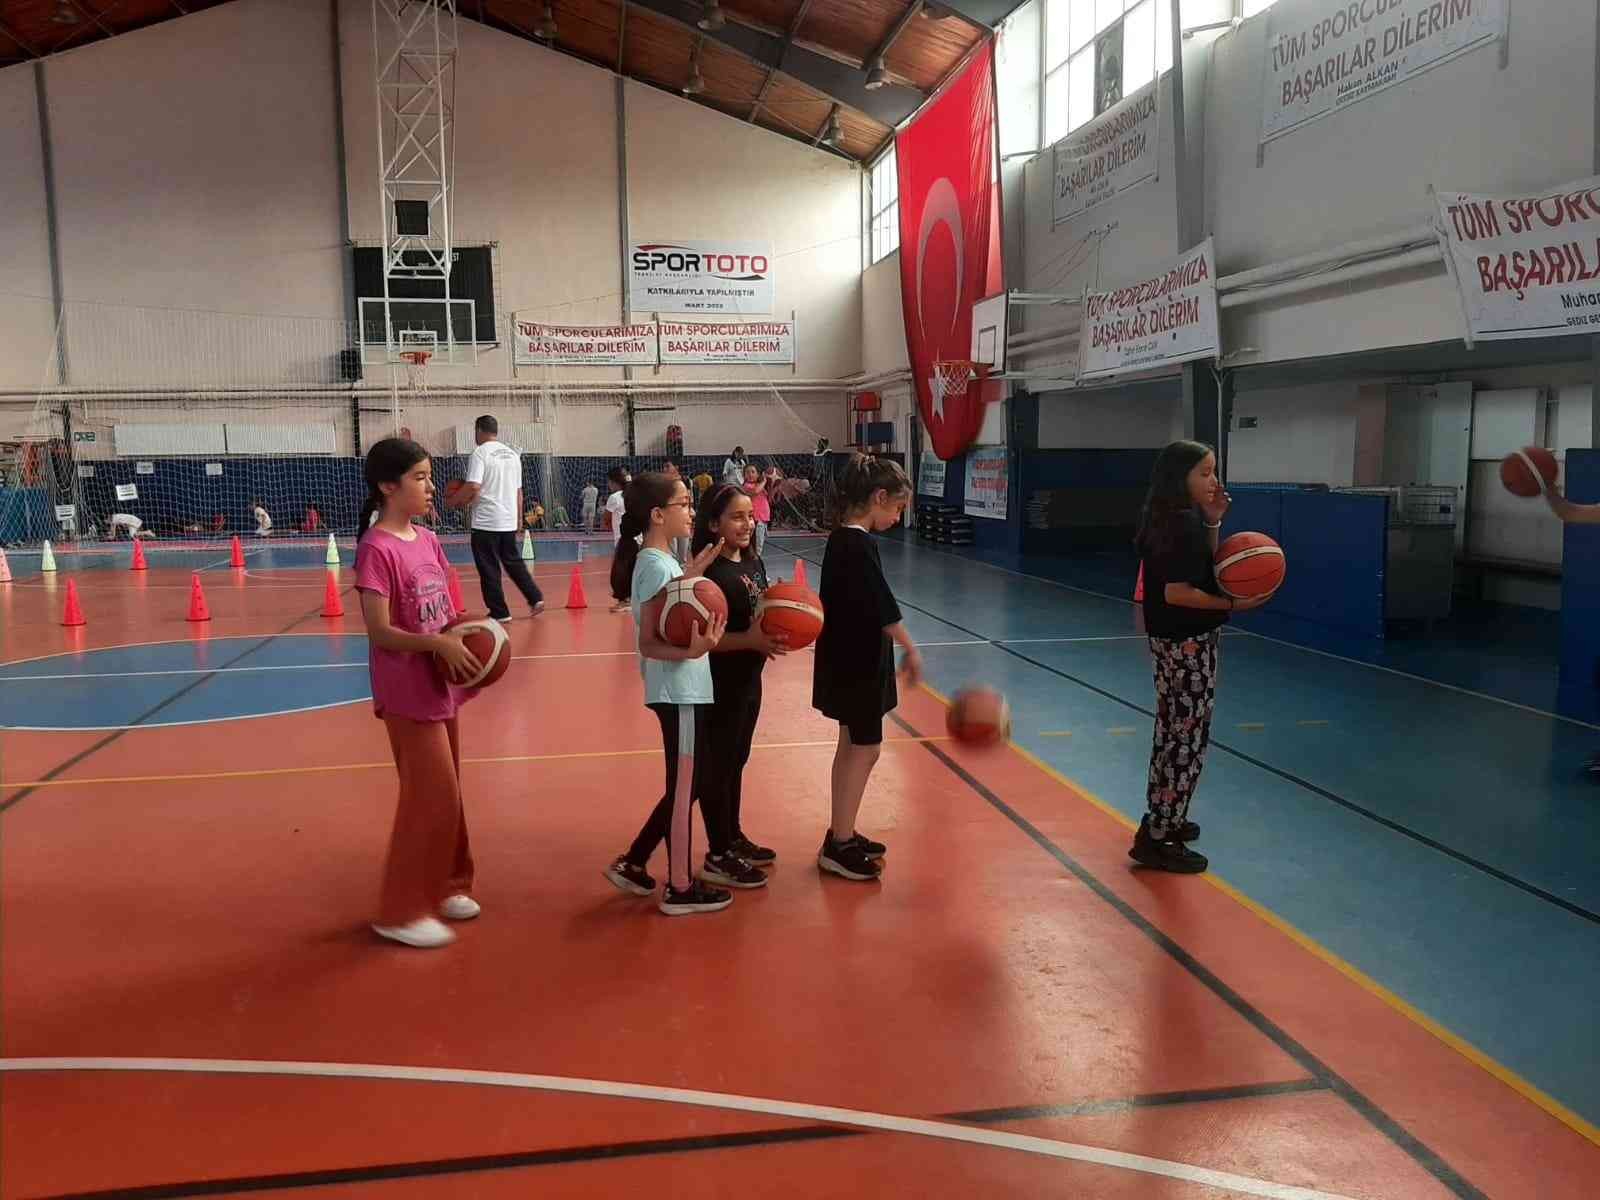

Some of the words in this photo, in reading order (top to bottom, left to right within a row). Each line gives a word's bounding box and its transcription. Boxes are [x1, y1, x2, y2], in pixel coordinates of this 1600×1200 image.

[1271, 34, 1306, 72] TÜM
[1281, 38, 1376, 105] BAŞARILAR
[1448, 194, 1501, 242] TÜM
[633, 252, 769, 274] SPORTOTO
[1477, 237, 1600, 301] BAŞARIL
[548, 325, 655, 338] SPORCULARIMIZA
[687, 322, 790, 336] SPORCULARIMIZA
